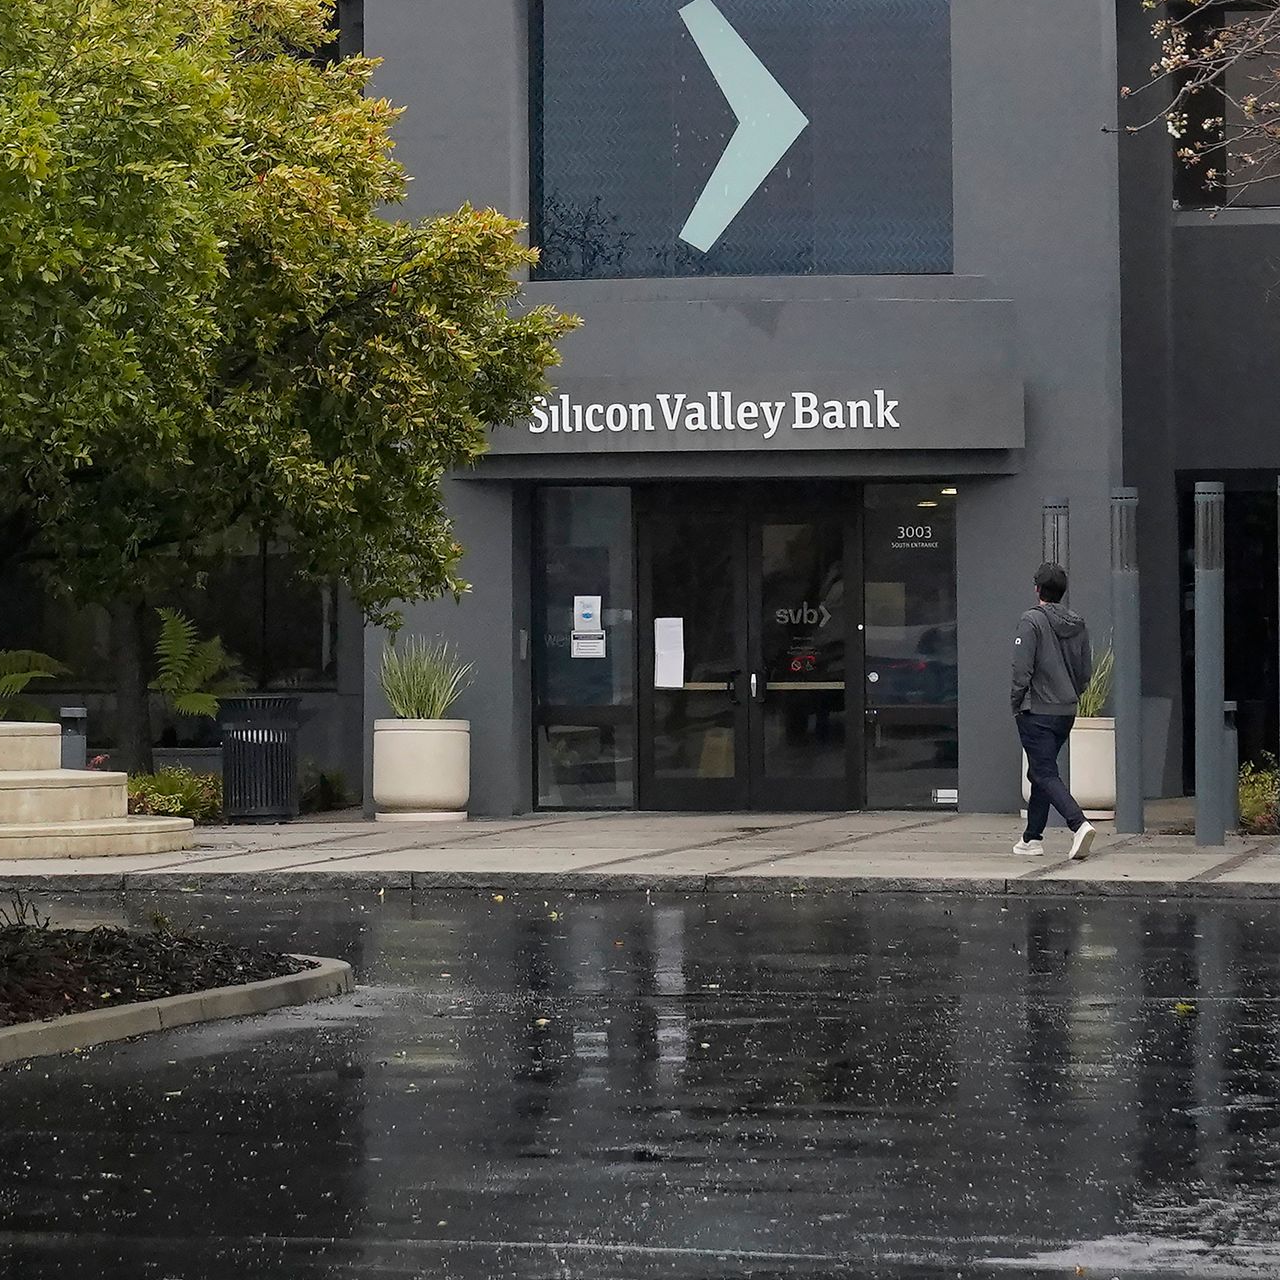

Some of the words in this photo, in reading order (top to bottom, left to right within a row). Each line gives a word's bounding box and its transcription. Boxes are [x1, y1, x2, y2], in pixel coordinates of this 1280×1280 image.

[529, 393, 655, 433] Silicon
[656, 391, 785, 439] Valley
[791, 389, 900, 430] Bank
[897, 526, 932, 539] 3003
[775, 601, 819, 624] svb
